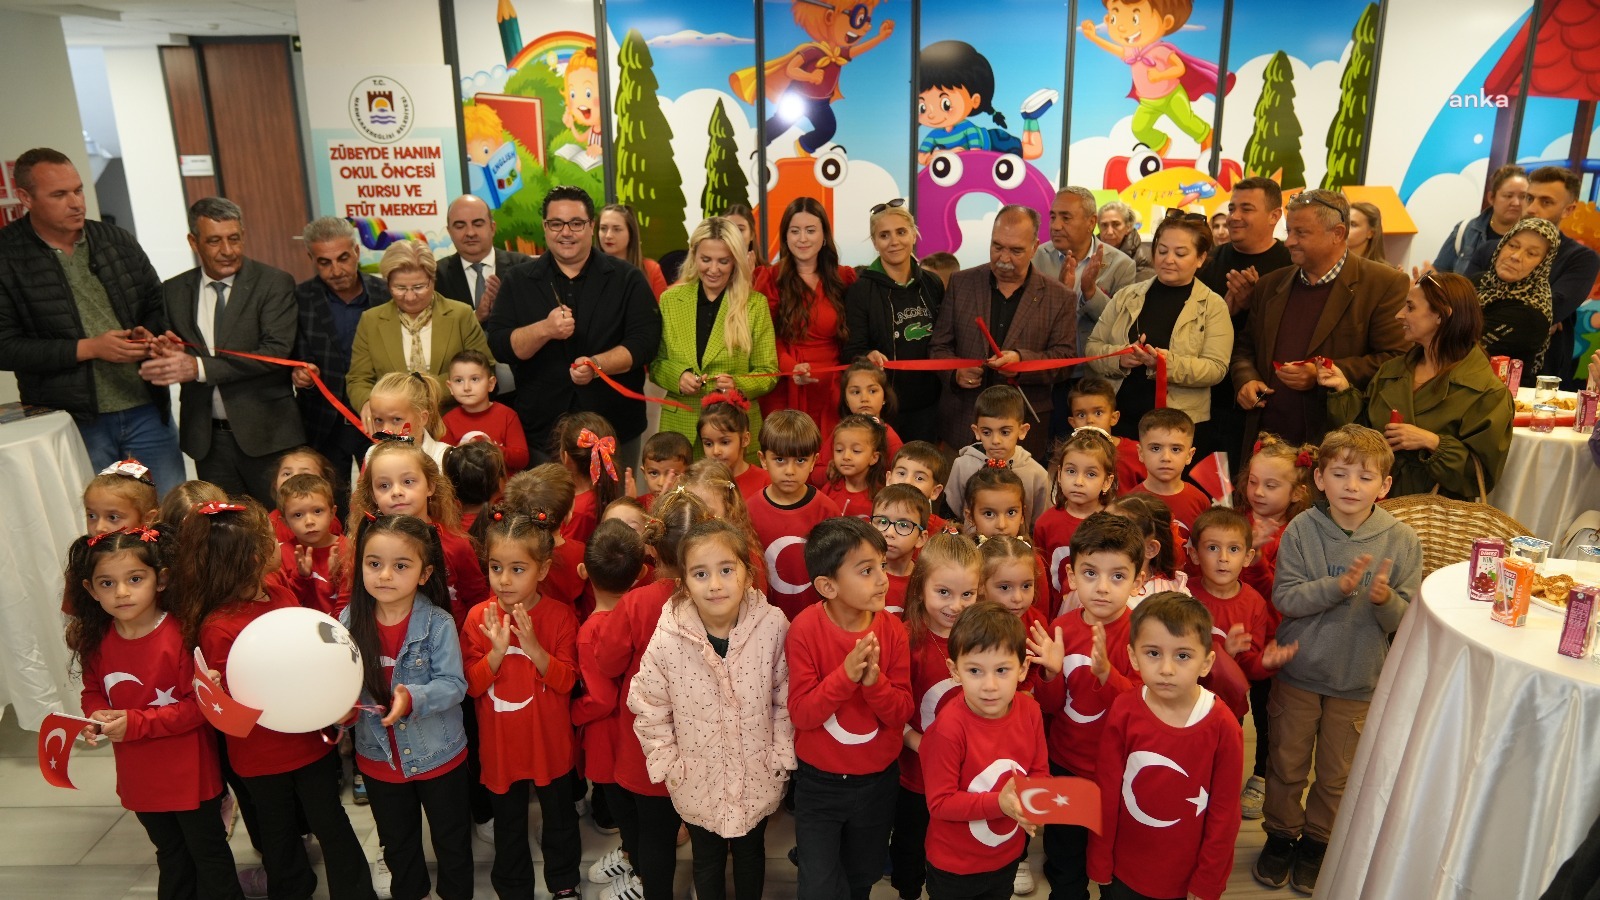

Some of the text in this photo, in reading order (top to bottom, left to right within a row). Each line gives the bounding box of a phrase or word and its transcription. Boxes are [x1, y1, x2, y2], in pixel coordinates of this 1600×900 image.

[329, 144, 441, 160] ZÜBEYDE HANIM
[339, 162, 436, 179] OKUL ÖNCESİ
[492, 151, 516, 175] ENGLISH
[357, 184, 422, 198] KURSU VE
[345, 200, 438, 217] ETÜT MERKEZİ
